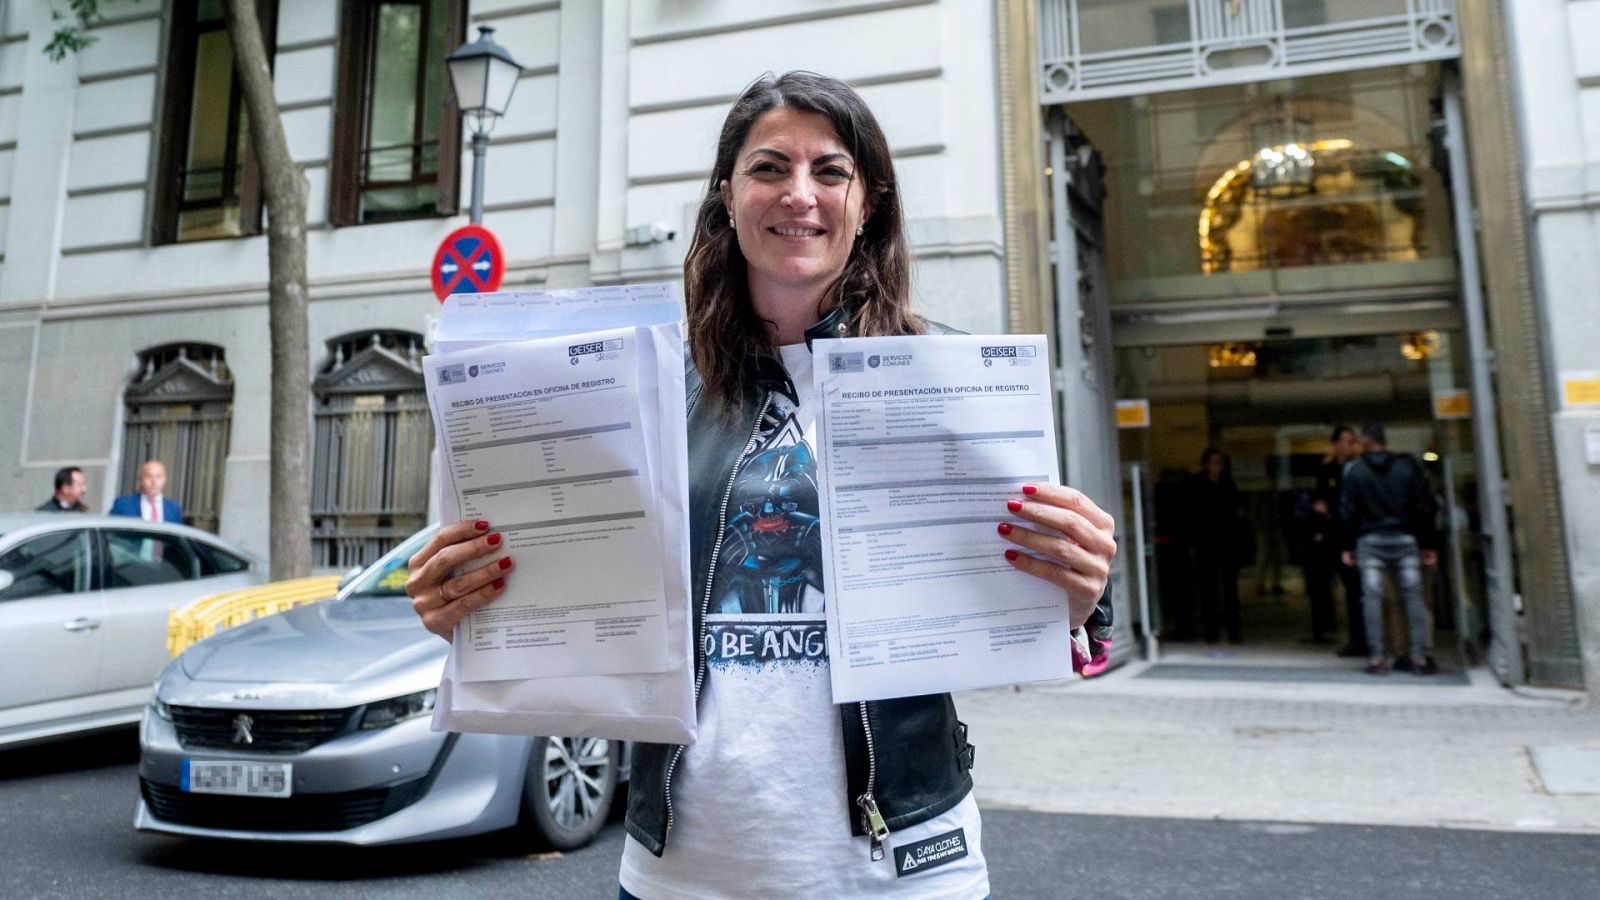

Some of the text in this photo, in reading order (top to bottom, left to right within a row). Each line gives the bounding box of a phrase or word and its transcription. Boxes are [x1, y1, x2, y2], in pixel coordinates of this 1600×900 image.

[570, 342, 602, 355] GEISER
[982, 347, 1015, 357] GEISER
[451, 377, 616, 408] RECIBO DE PRESENTACIÓN EN OFICINA DE REGISTRO
[841, 391, 871, 399] RECIBO
[871, 390, 883, 398] DE
[884, 386, 942, 397] PRESENTACIÓN
[943, 386, 953, 394] EN
[954, 385, 983, 393] OFICINA
[995, 384, 1030, 392] REGISTRO
[704, 634, 716, 656] O
[721, 632, 755, 658] BE
[761, 630, 829, 658] ANG
[935, 836, 961, 851] CLOTHES
